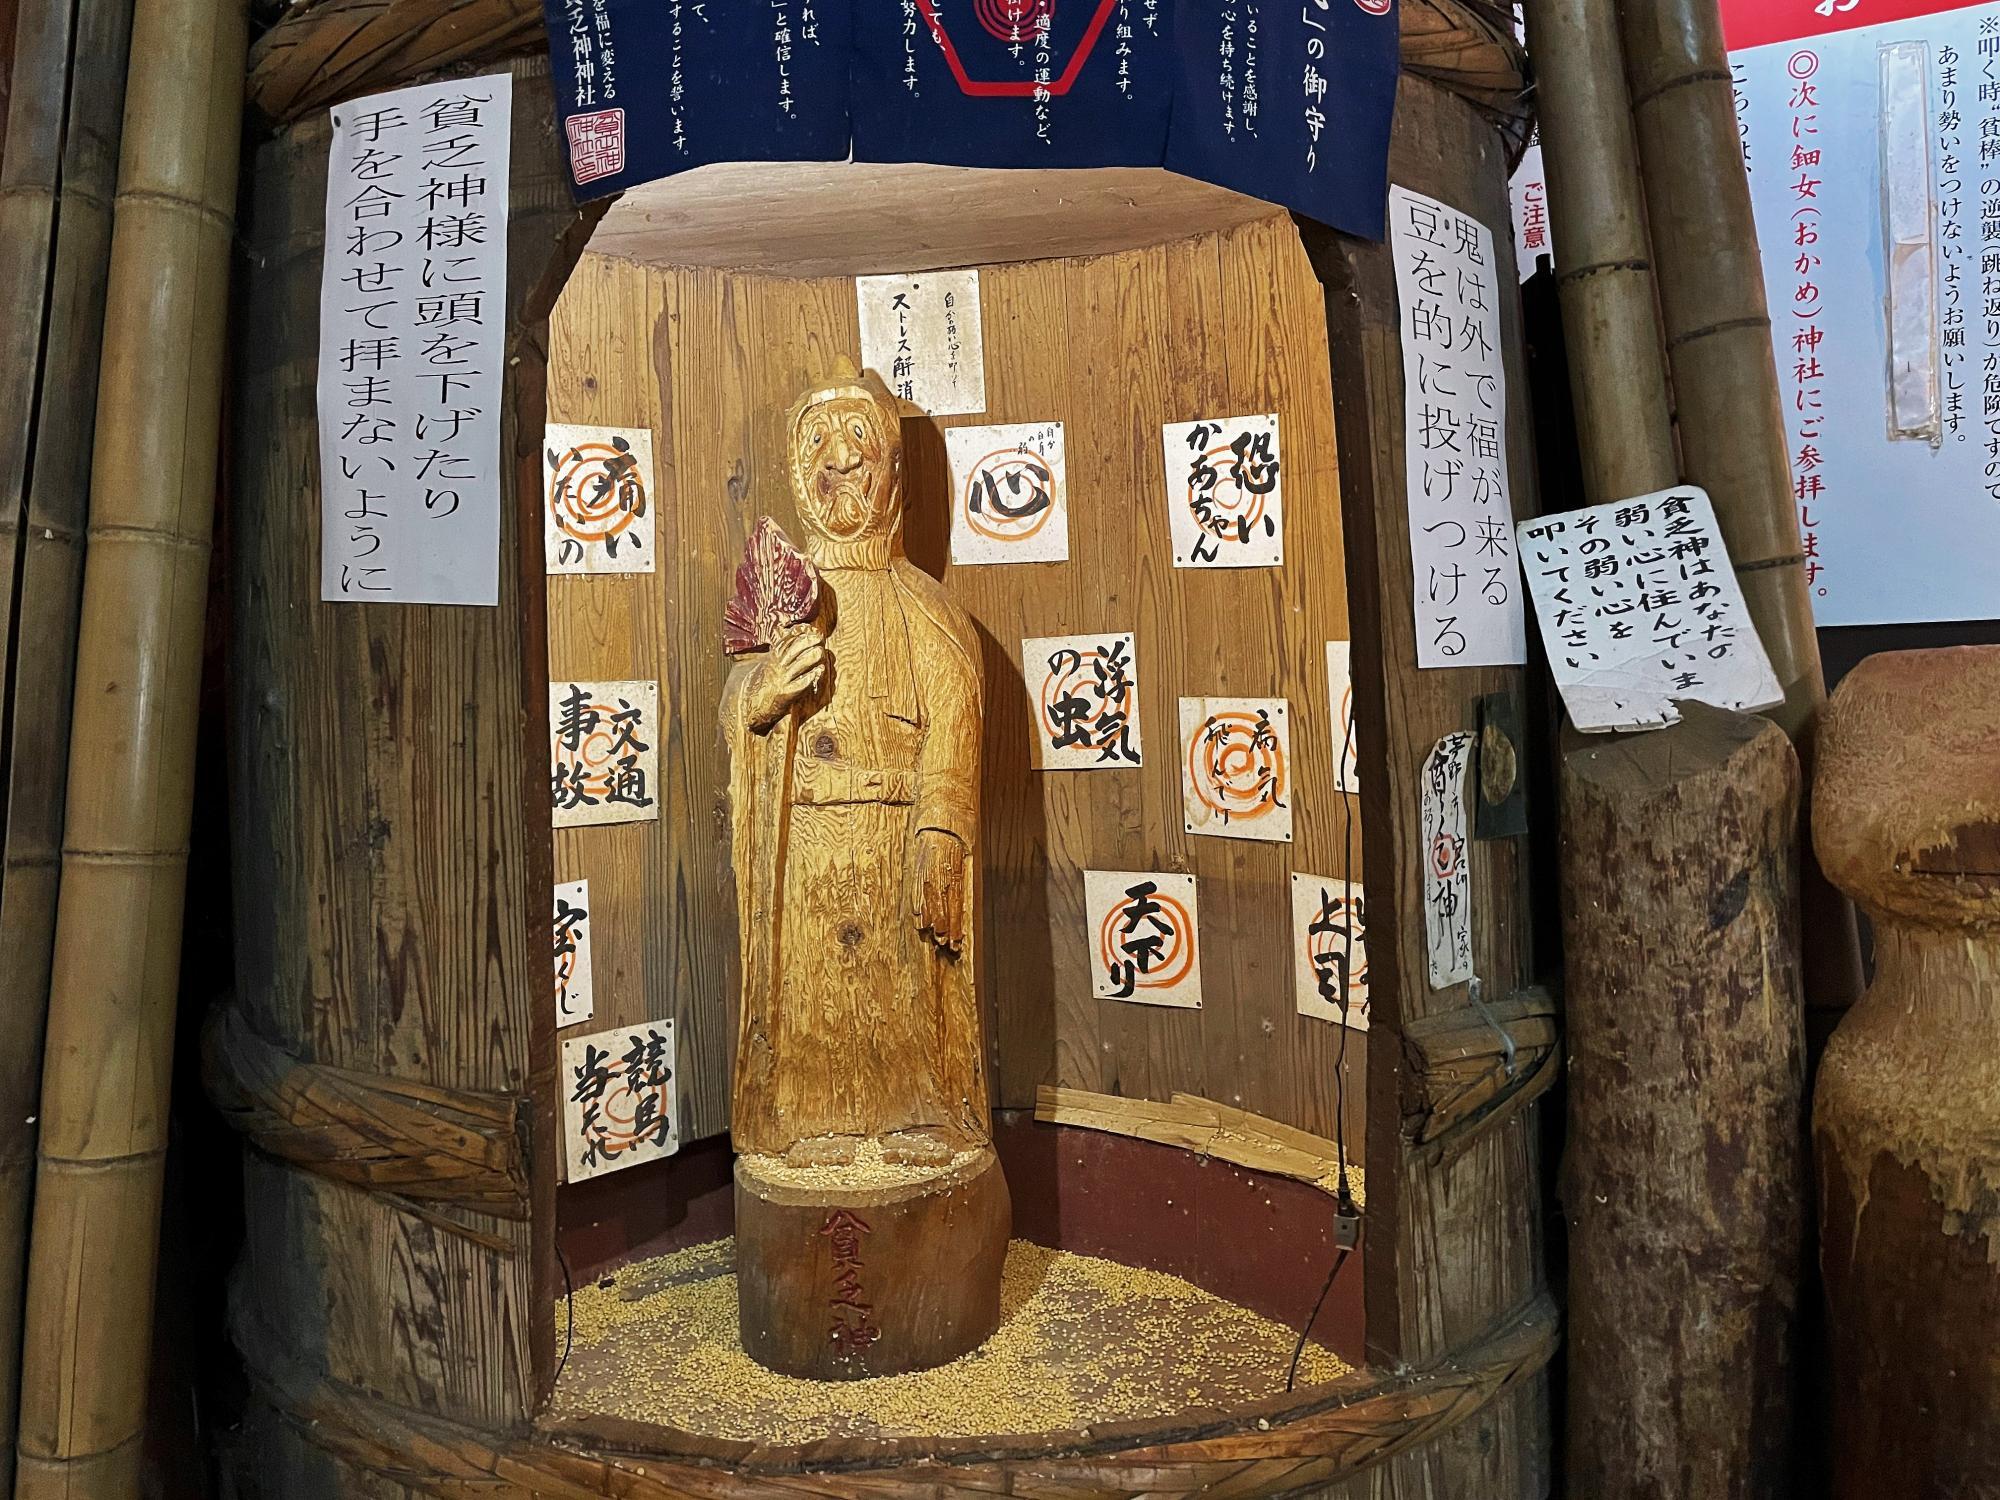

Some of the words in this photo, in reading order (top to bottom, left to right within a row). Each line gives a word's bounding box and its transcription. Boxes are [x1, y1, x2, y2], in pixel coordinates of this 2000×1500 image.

[669, 0, 689, 155] することを誓います。
[802, 0, 820, 46] れば、
[1115, 0, 1133, 100] り組みます。
[1219, 0, 1237, 142] 心を持ち続けます。
[1523, 182, 1545, 249] ご注意
[1938, 45, 1966, 442] あまり勢いをつけないようお願いします。
[339, 107, 407, 593] 手を合わせて拝まないように
[412, 94, 492, 519] 貧乏神様に頭を下げたり
[892, 293, 916, 401] ストレス解消
[1402, 196, 1466, 656] 豆を的に投げつける
[1453, 217, 1508, 606] 鬼は外で福が来る
[969, 463, 1051, 518] 心
[1186, 423, 1230, 563] かあちゃん
[1526, 521, 1600, 668] 叩いてください
[1574, 515, 1635, 639] その弱い心を
[1655, 496, 1735, 659] 貧乏神はあなたの
[552, 683, 600, 809] 事故
[604, 698, 654, 808] 交通
[1047, 649, 1092, 750] の虫
[1093, 640, 1141, 765] 浮気
[1105, 881, 1175, 998] 天下り
